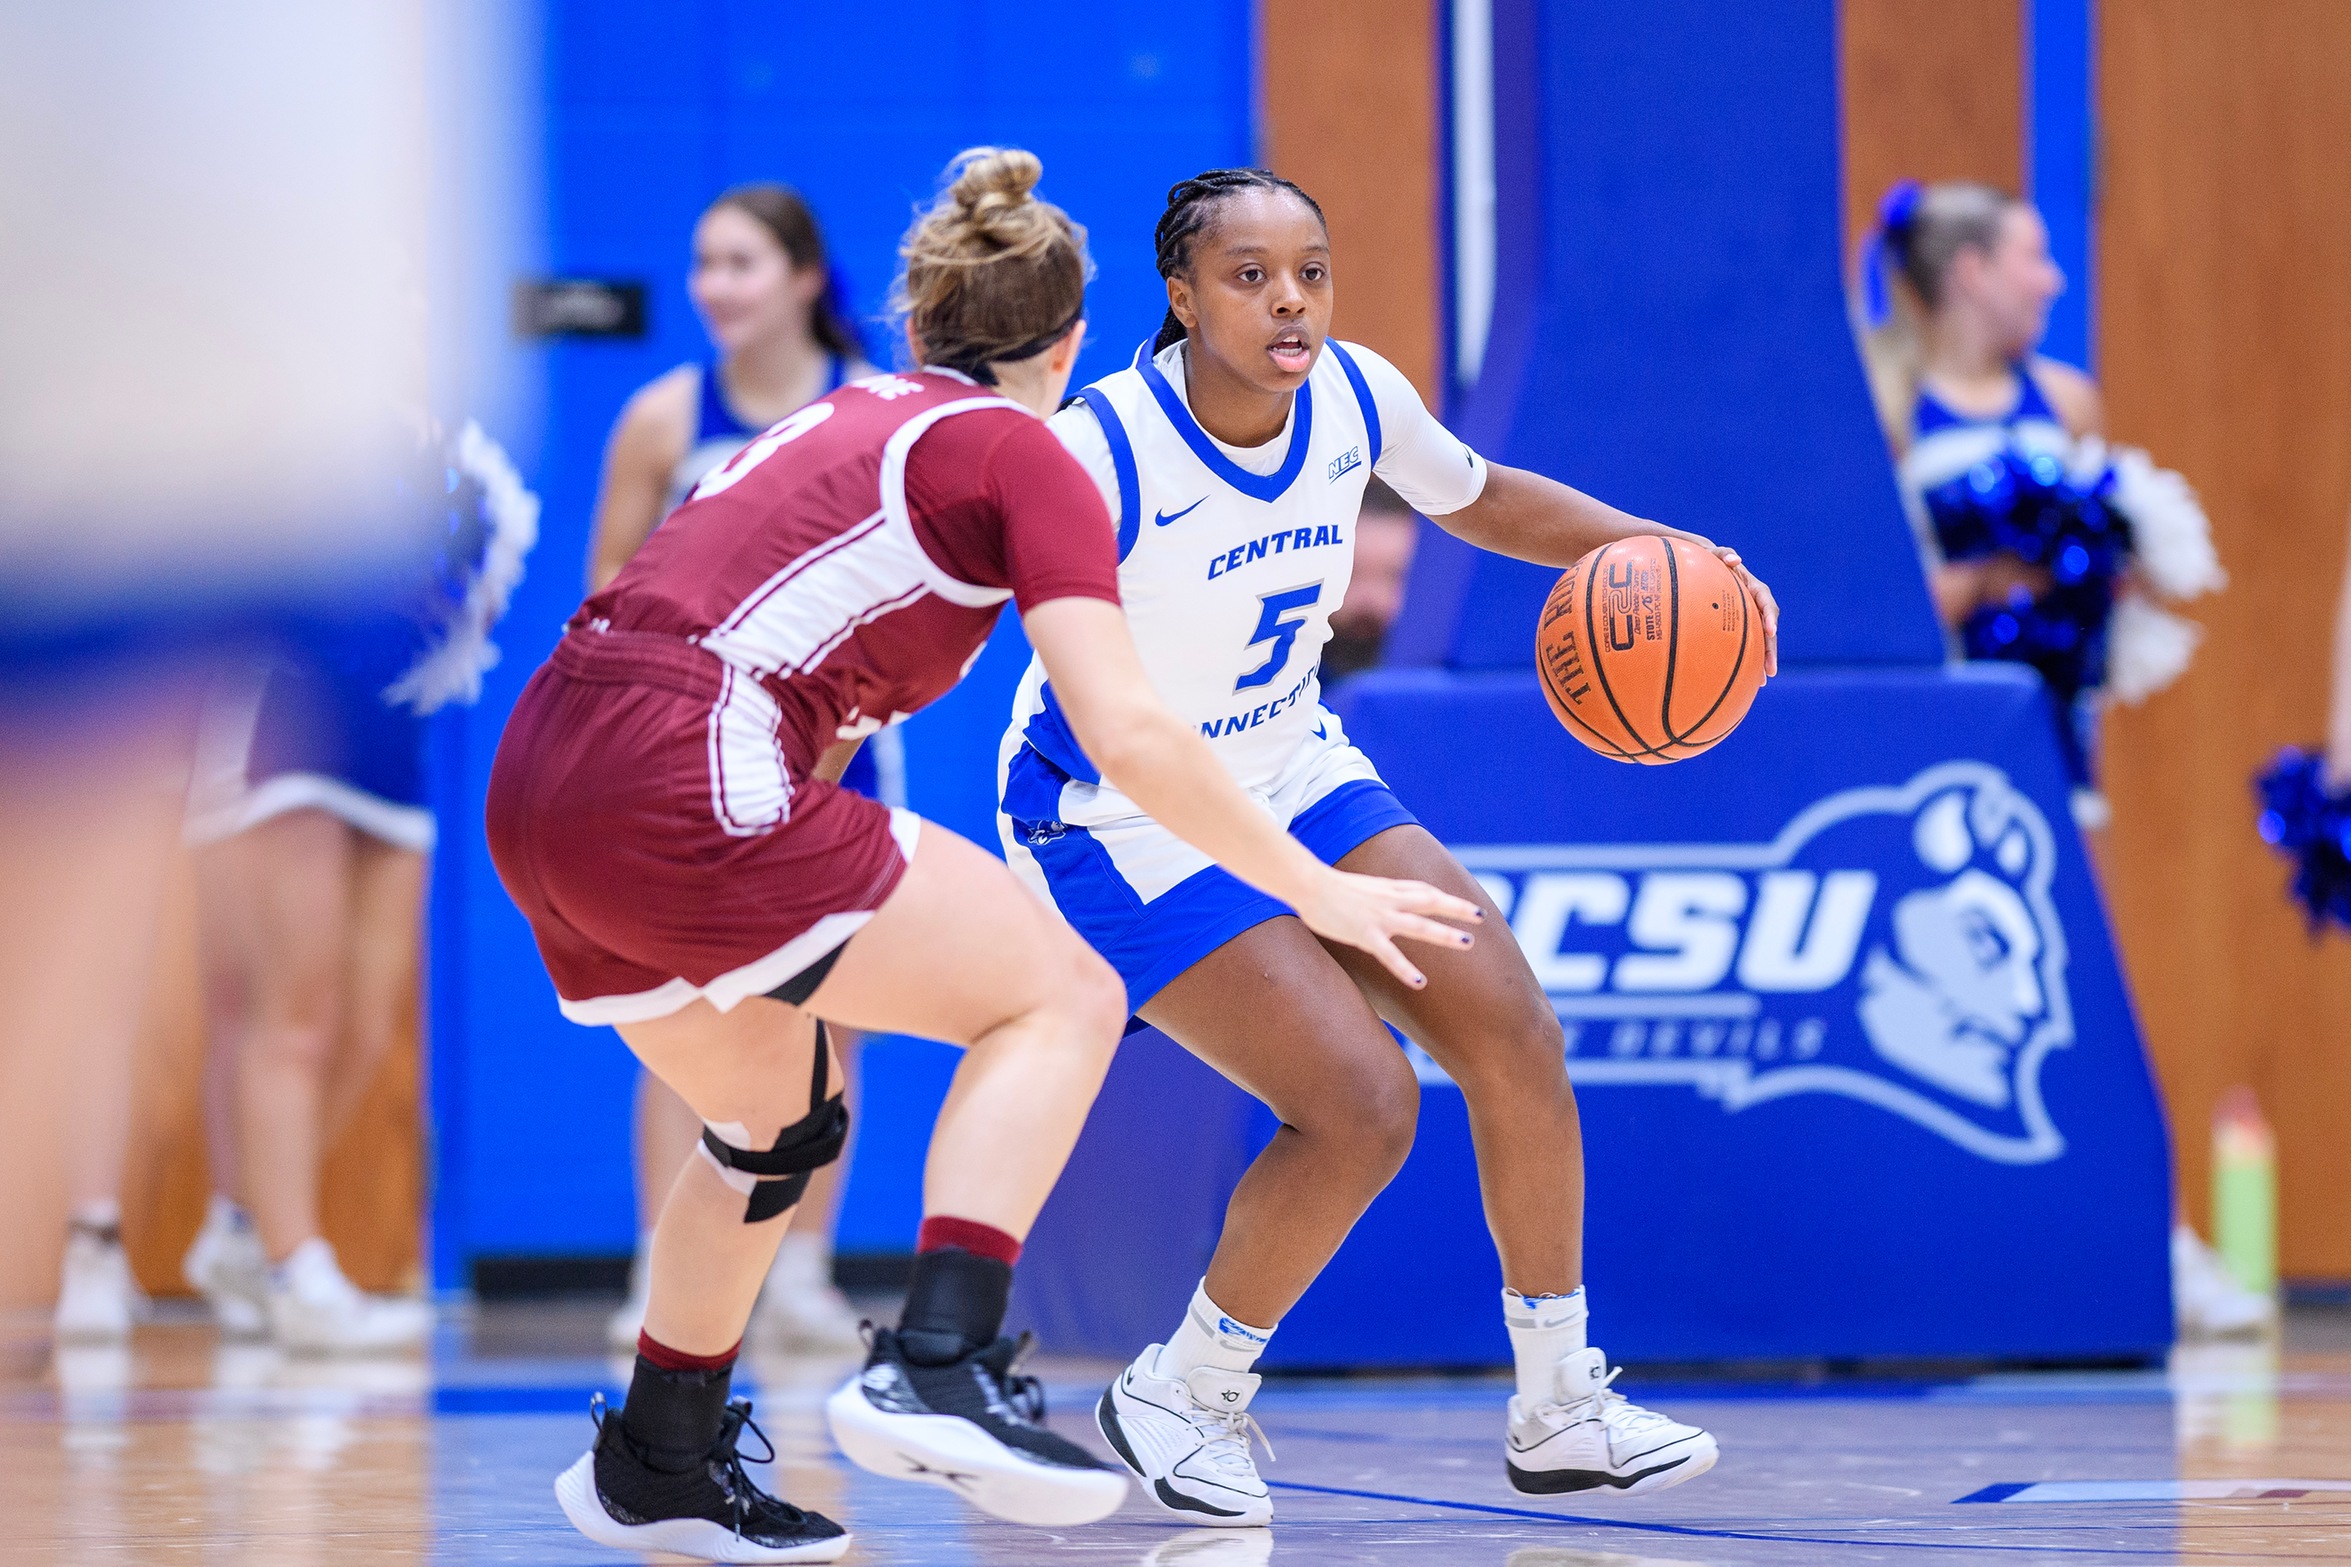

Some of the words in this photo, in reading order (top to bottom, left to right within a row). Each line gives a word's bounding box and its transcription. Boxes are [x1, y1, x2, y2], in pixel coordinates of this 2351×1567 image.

[1328, 445, 1359, 480] NEC
[1207, 524, 1344, 581] CENTRAL
[1232, 577, 1325, 697] 5
[1545, 630, 1592, 705] THE
